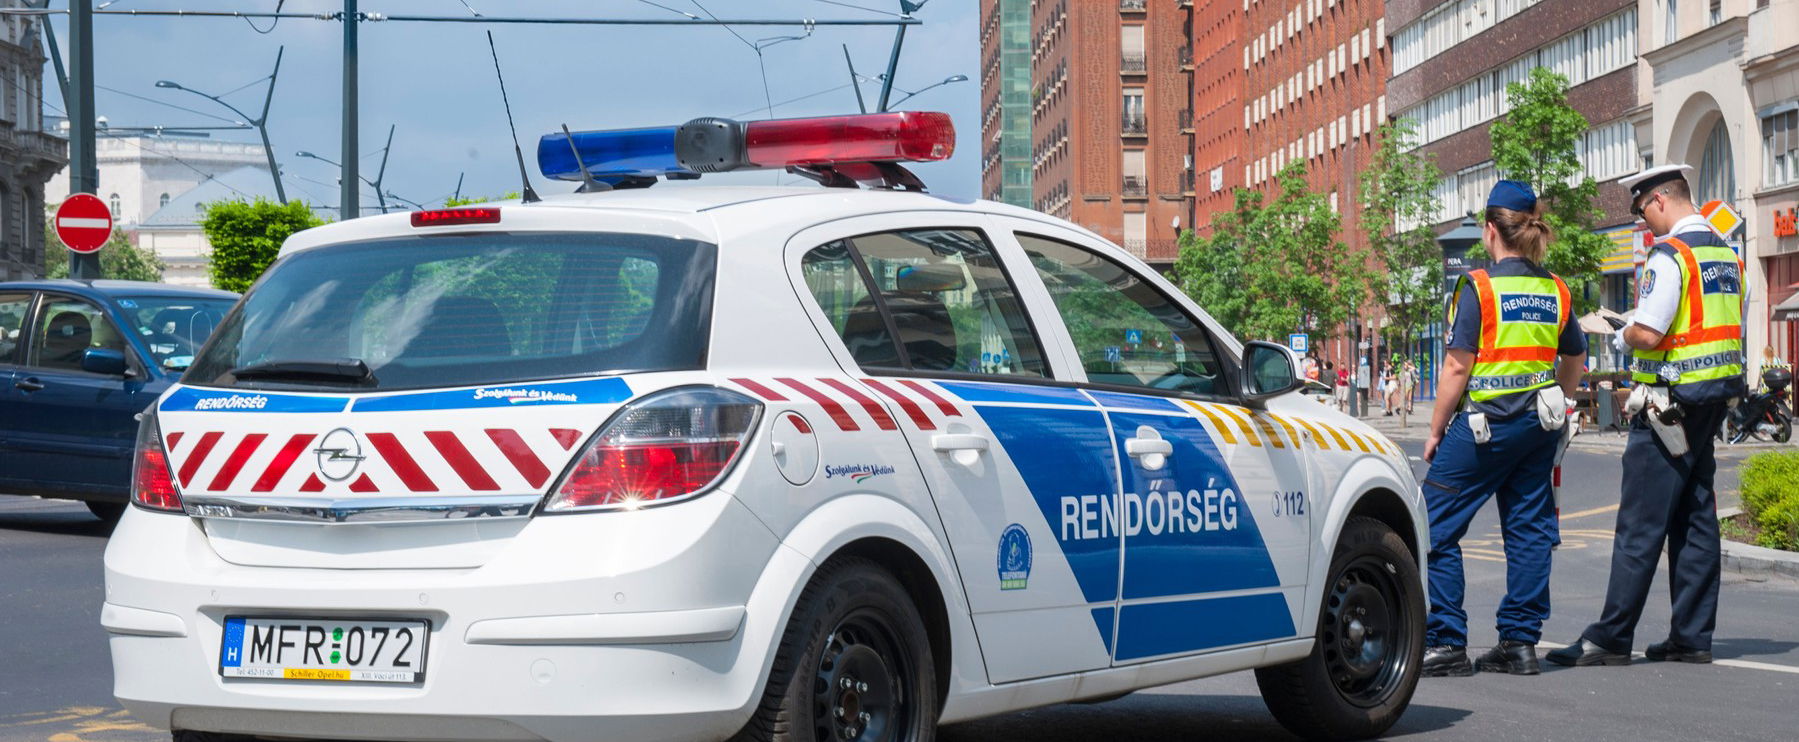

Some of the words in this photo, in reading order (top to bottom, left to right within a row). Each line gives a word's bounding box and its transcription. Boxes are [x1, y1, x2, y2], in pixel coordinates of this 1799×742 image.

[1502, 294, 1557, 314] RENDŐRSÉG
[1521, 312, 1541, 321] POLICE
[1480, 375, 1530, 388] POLICE
[528, 389, 540, 397] és
[194, 394, 268, 410] RENDŐRSÉG
[825, 464, 861, 478] Szolgálunk
[1060, 478, 1238, 541] RENDŐRSÉG
[1283, 491, 1304, 516] 112
[227, 647, 238, 662] H
